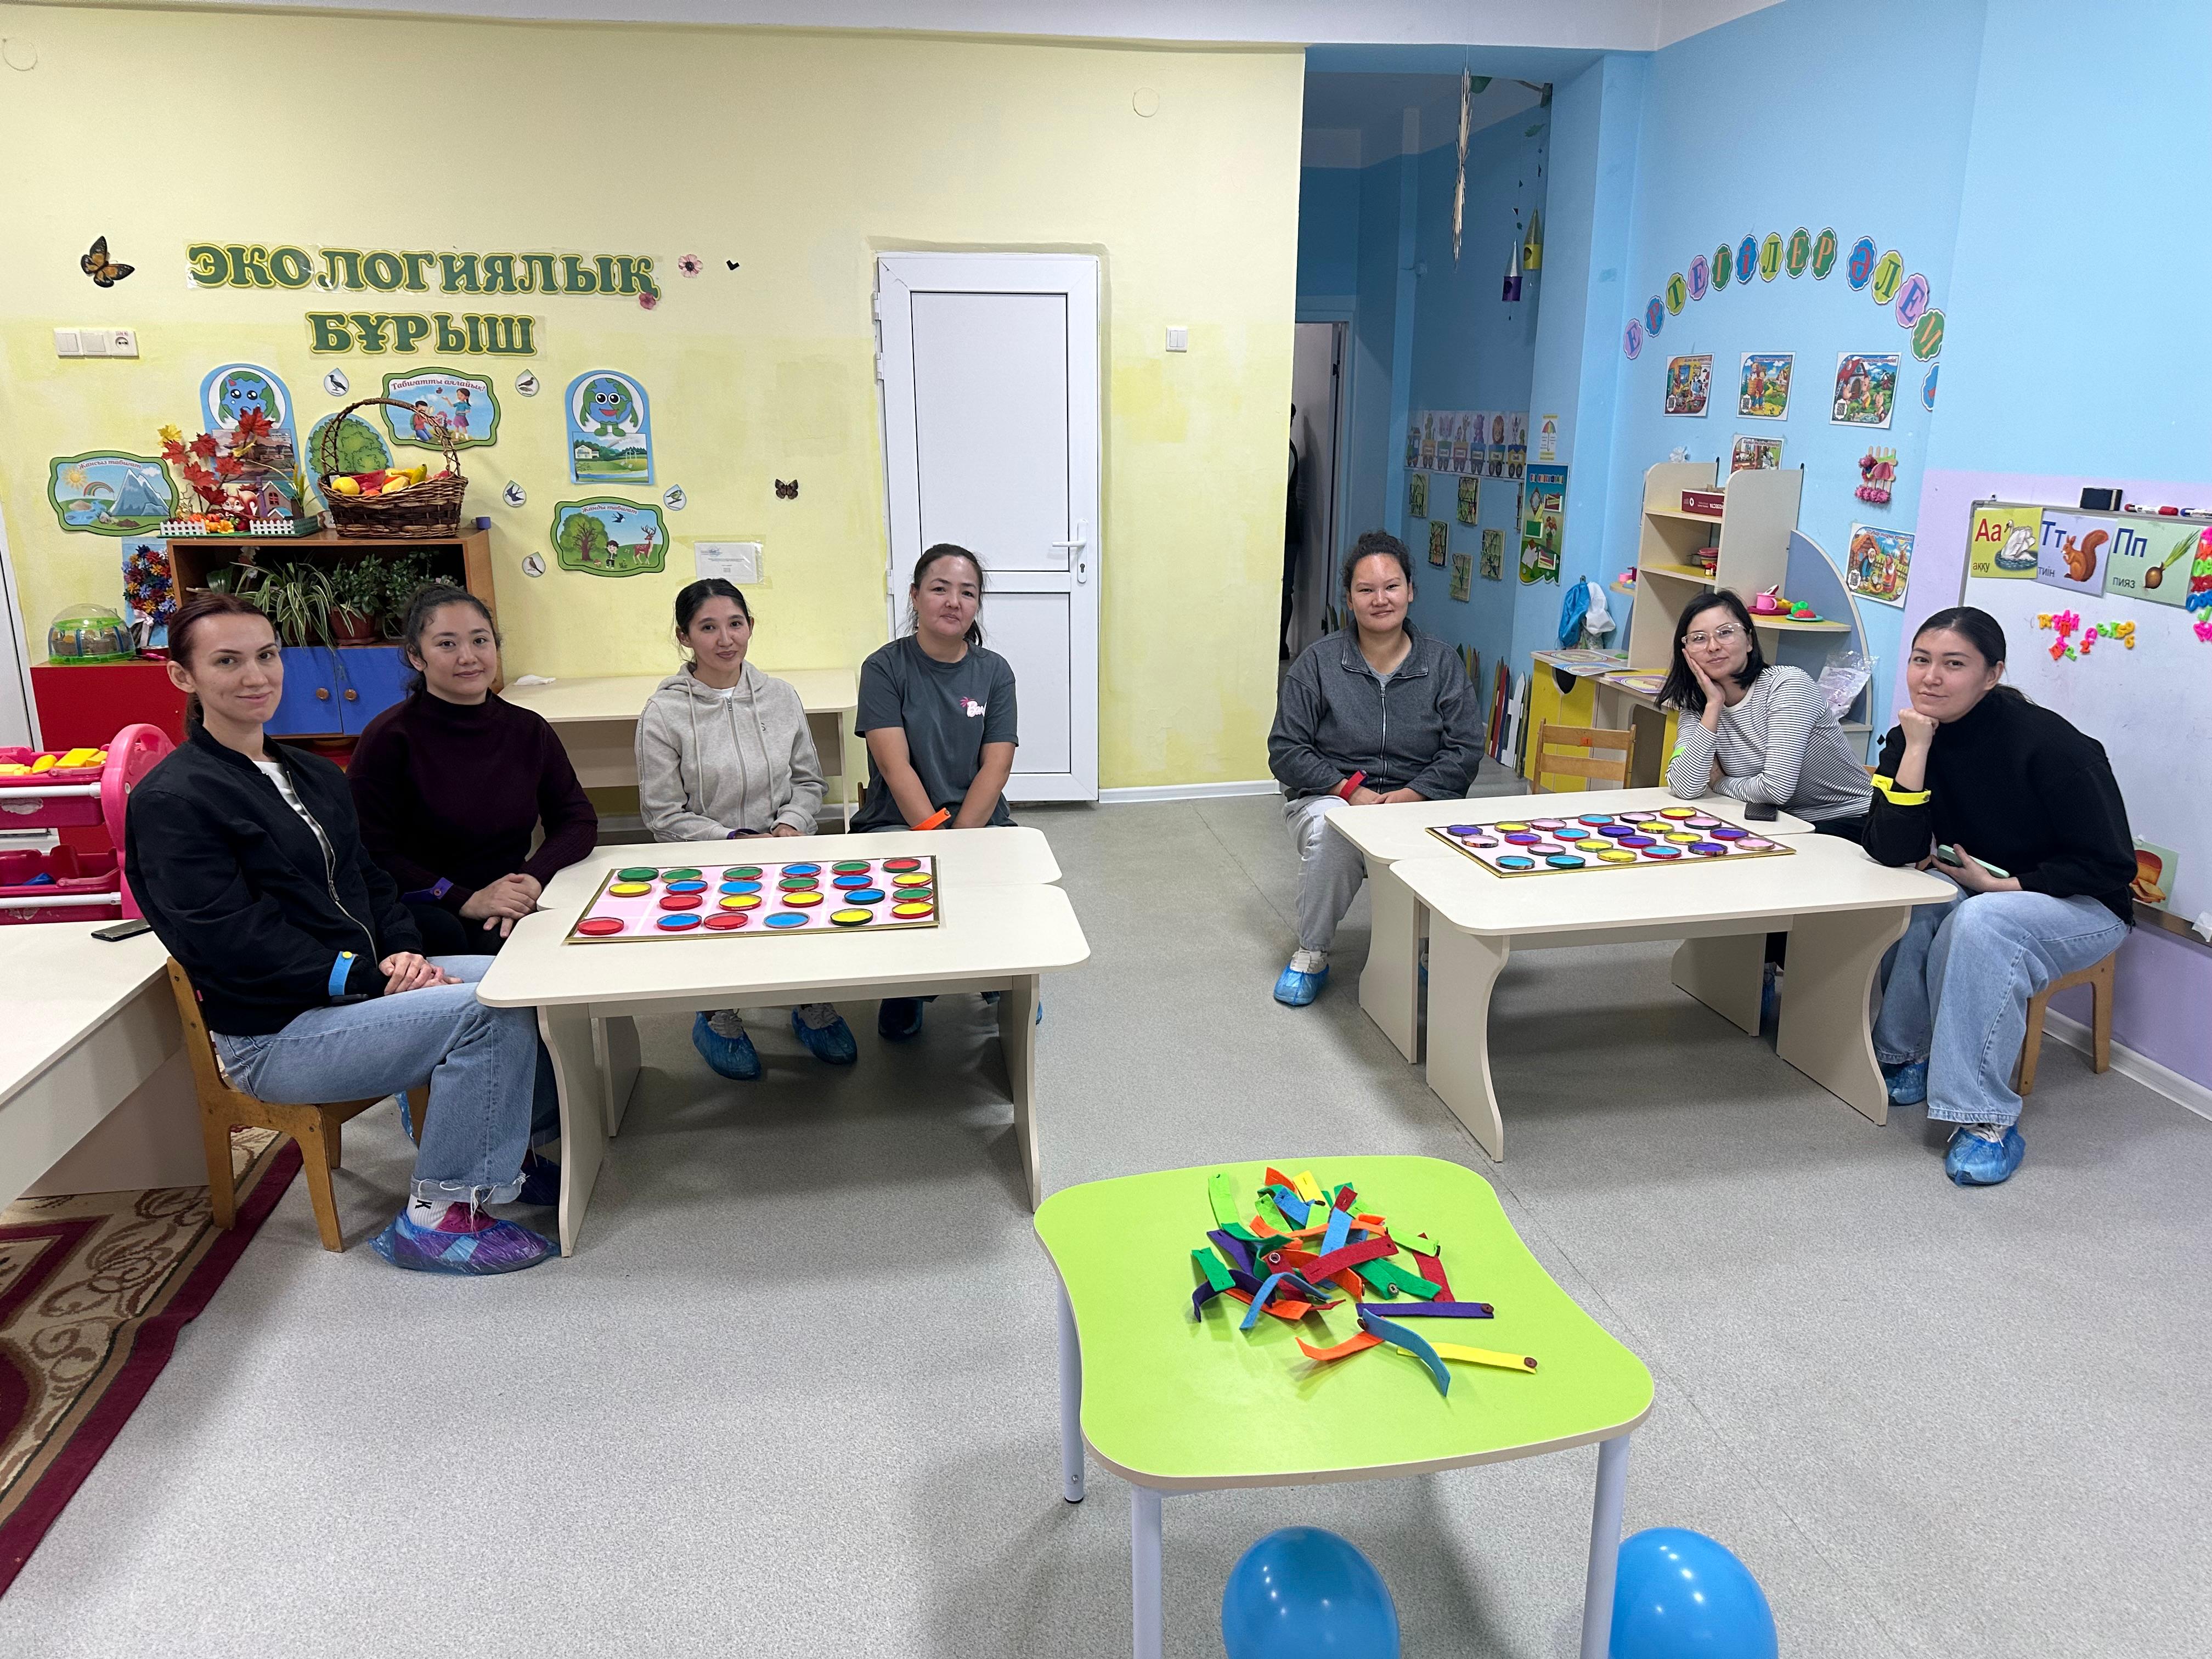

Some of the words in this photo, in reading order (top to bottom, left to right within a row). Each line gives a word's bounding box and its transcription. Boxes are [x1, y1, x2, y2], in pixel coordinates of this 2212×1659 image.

[186, 243, 661, 300] ЭКОЛОГИЯЛЫҚ
[306, 311, 537, 357] БҰРЫШ
[1852, 247, 1942, 400] ӘЛЕМ
[1975, 518, 2002, 542] Аа
[2113, 527, 2148, 558] Пп
[2113, 577, 2136, 589] пияз
